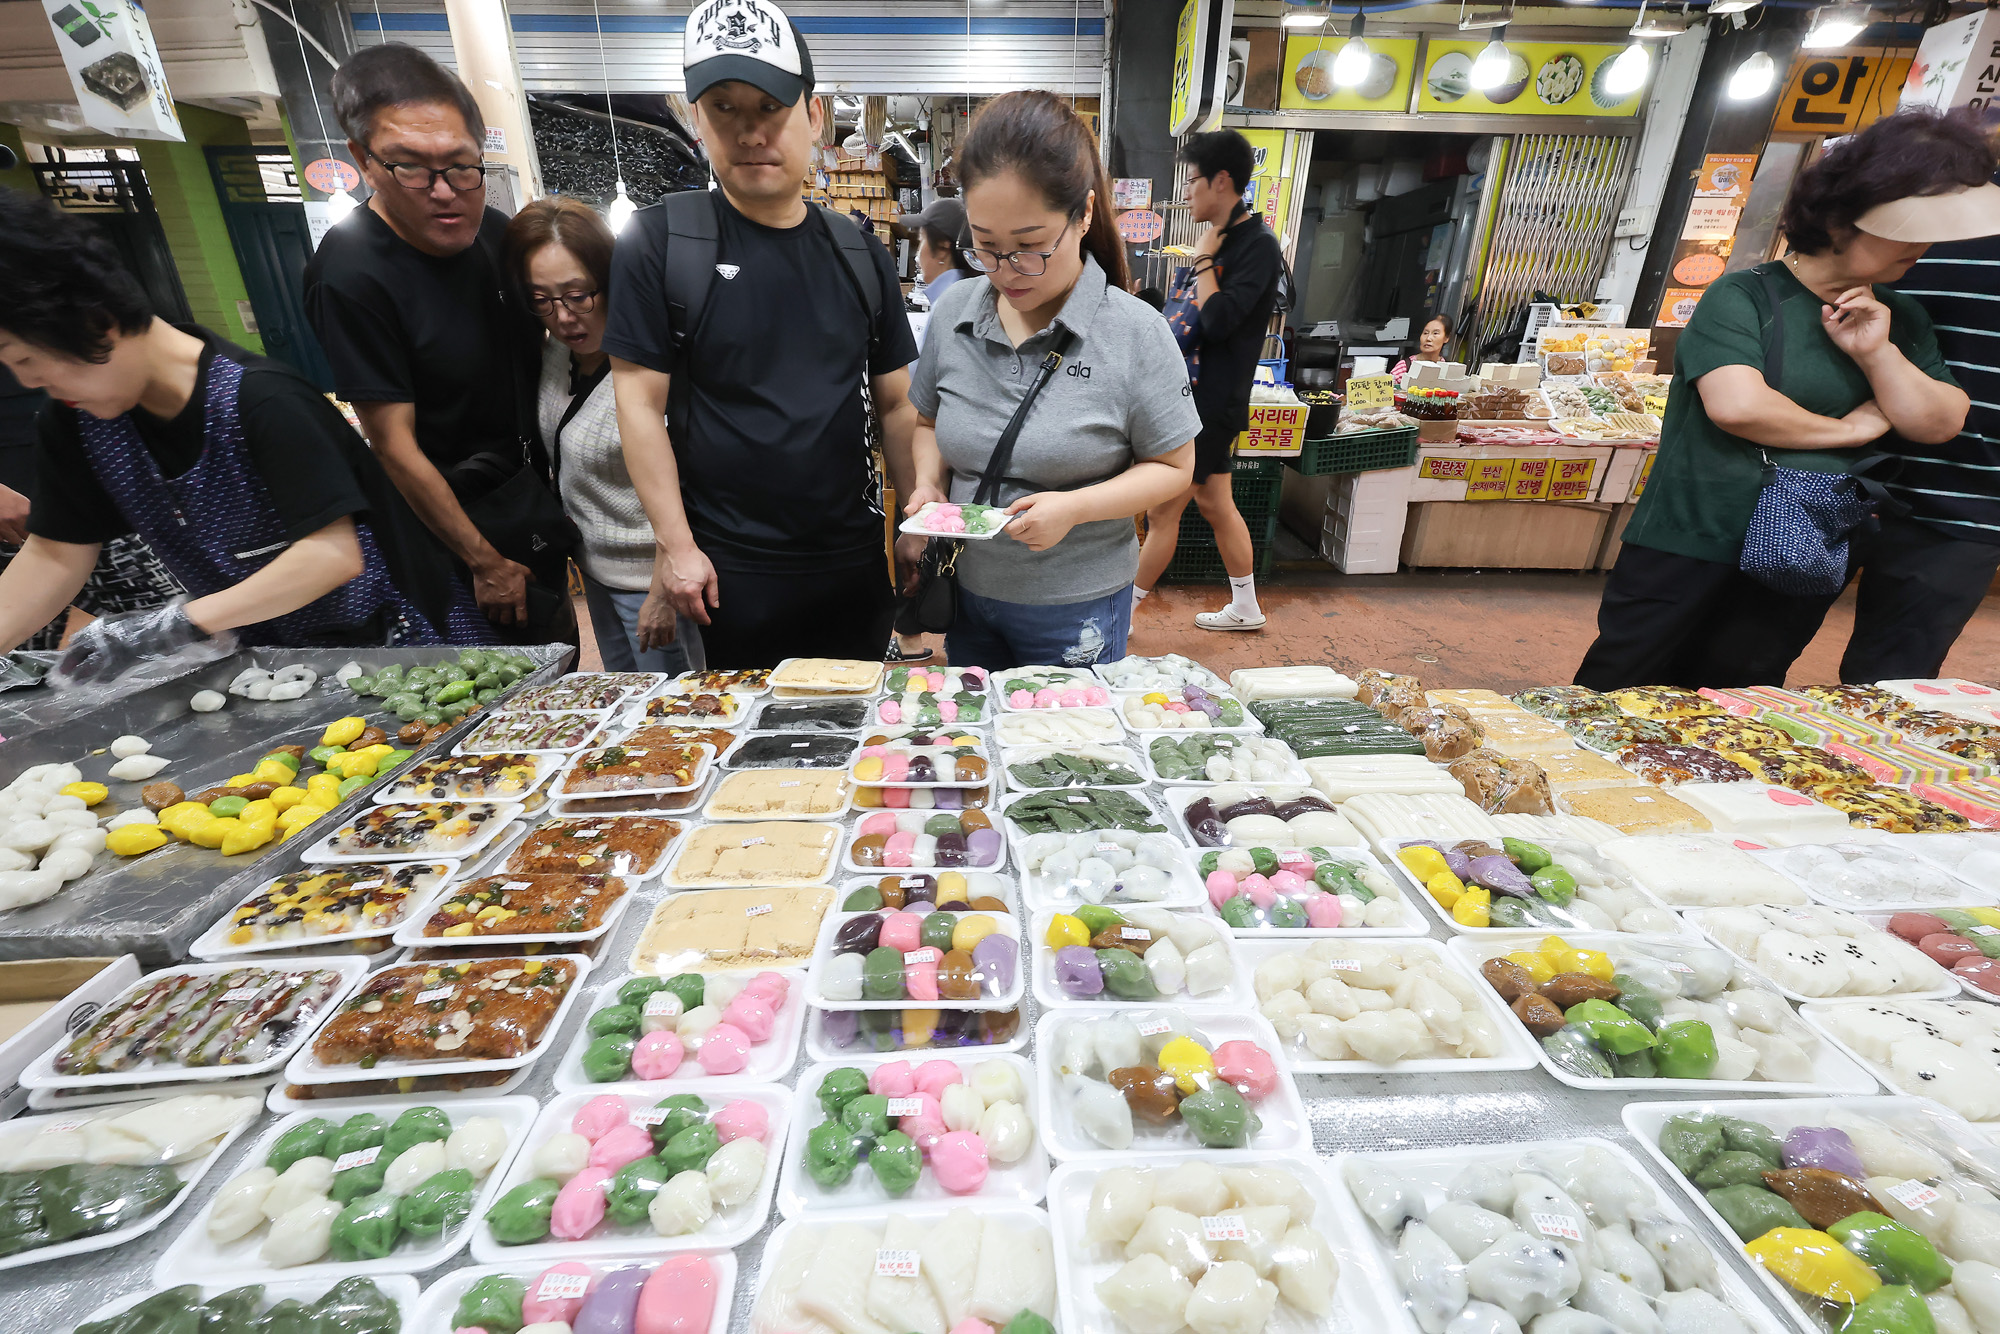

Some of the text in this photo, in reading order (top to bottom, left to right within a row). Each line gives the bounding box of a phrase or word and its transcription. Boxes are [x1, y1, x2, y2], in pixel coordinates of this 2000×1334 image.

[1249, 408, 1298, 425] 서리태
[1246, 428, 1294, 447] 콩국물
[1481, 466, 1503, 478] 부산
[1520, 461, 1548, 475] 메밀
[1561, 462, 1588, 478] 감자
[1470, 480, 1507, 493] 수제어묵
[1515, 479, 1542, 495] 전병
[1551, 480, 1588, 496] 왕만두
[1542, 1226, 1578, 1238] 판매가격
